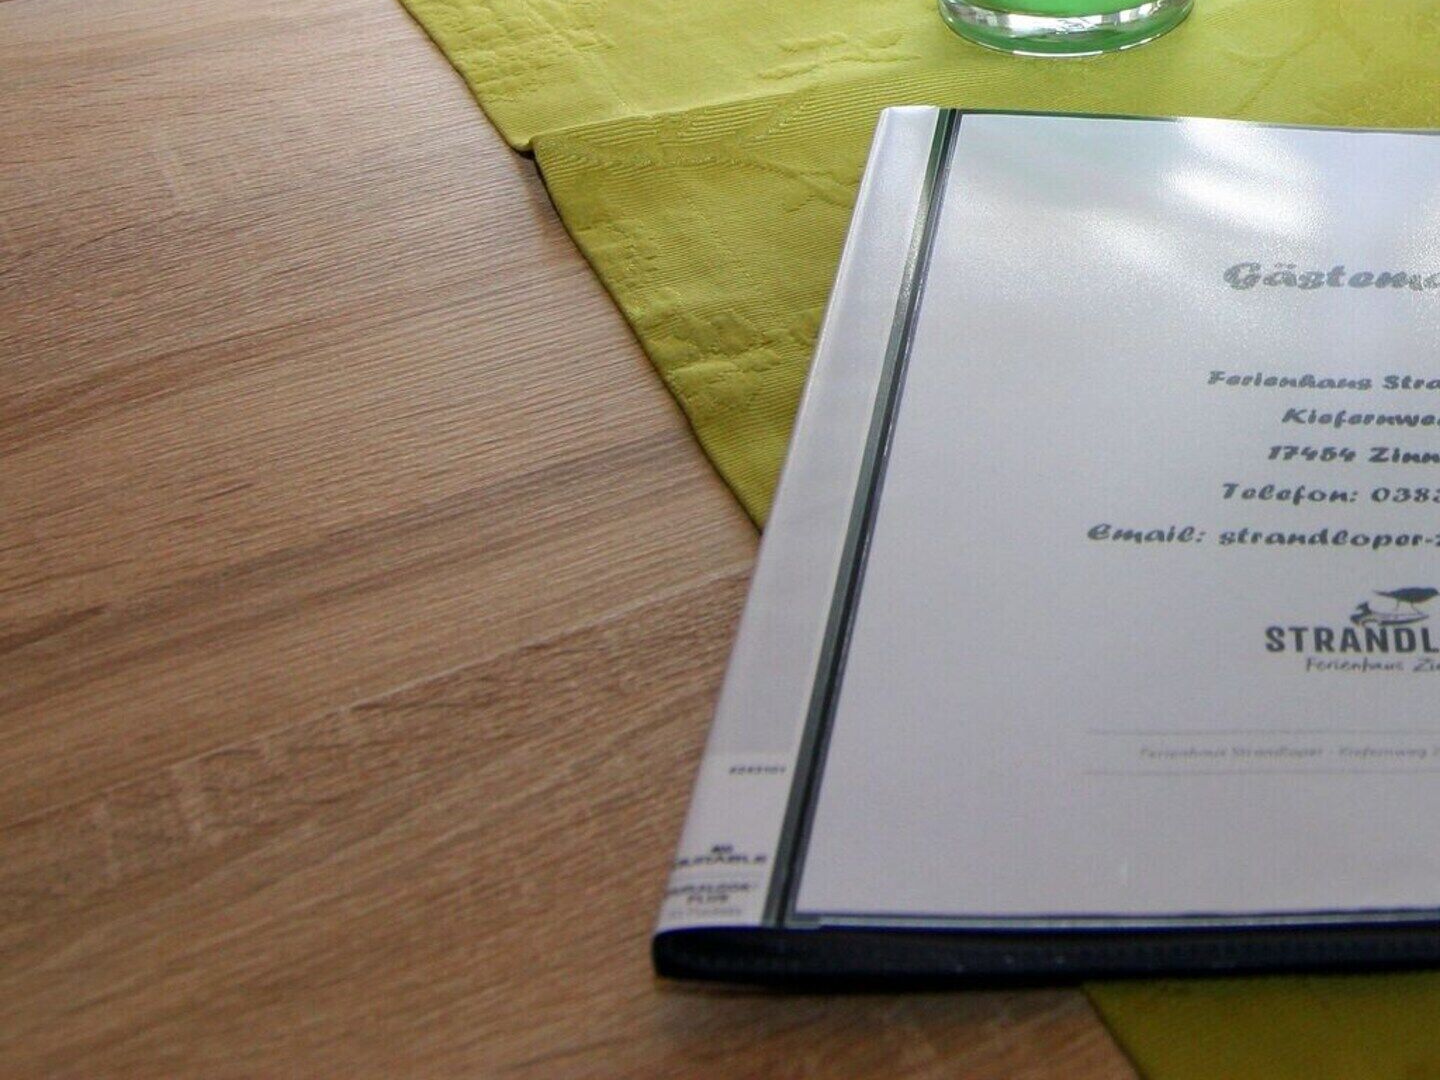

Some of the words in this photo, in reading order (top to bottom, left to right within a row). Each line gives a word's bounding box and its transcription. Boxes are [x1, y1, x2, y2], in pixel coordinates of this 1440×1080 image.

[1207, 370, 1373, 391] Ferienhaus
[1267, 445, 1357, 463] 17454
[1222, 481, 1359, 506] Telefon:
[1086, 522, 1206, 544] Email:
